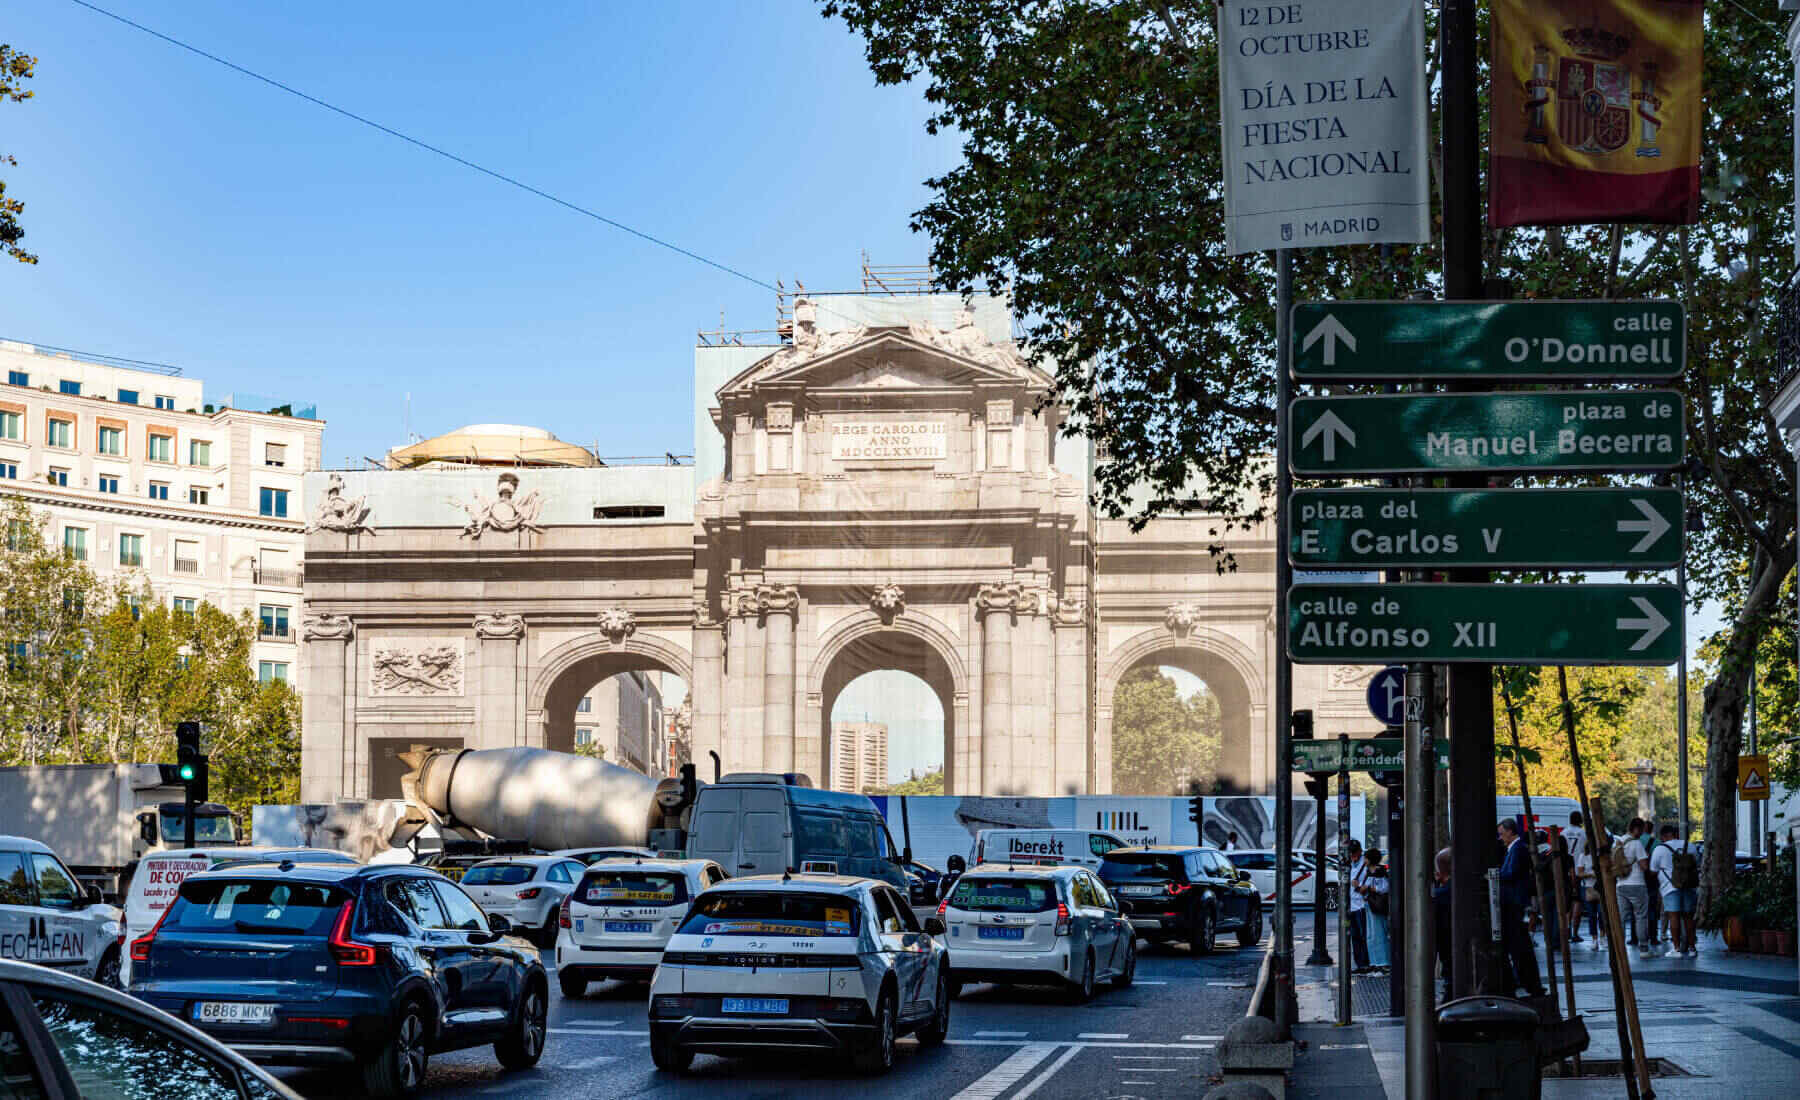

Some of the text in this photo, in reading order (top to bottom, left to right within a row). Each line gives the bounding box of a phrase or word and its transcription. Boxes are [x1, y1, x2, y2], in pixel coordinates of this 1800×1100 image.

[1240, 4, 1303, 26] 12 DE
[1239, 29, 1369, 57] OCTUBRE
[1240, 76, 1398, 110] DÍA DE LA
[1242, 116, 1349, 148] FIESTA
[1245, 151, 1411, 184] NACIONAL
[1305, 218, 1380, 236] MADRID
[1614, 312, 1672, 331] calle
[1504, 337, 1672, 363] O'Donnell
[1563, 400, 1672, 424] plaza de
[869, 436, 911, 446] ANNO
[1426, 429, 1672, 457] Manuel Becerra
[1302, 500, 1418, 522] plaza del
[1302, 528, 1502, 554] E. Carlos V
[1300, 597, 1400, 615] calle de
[1300, 621, 1496, 647] Alfonso XII
[1008, 835, 1064, 855] Iberext
[150, 872, 163, 884] DE
